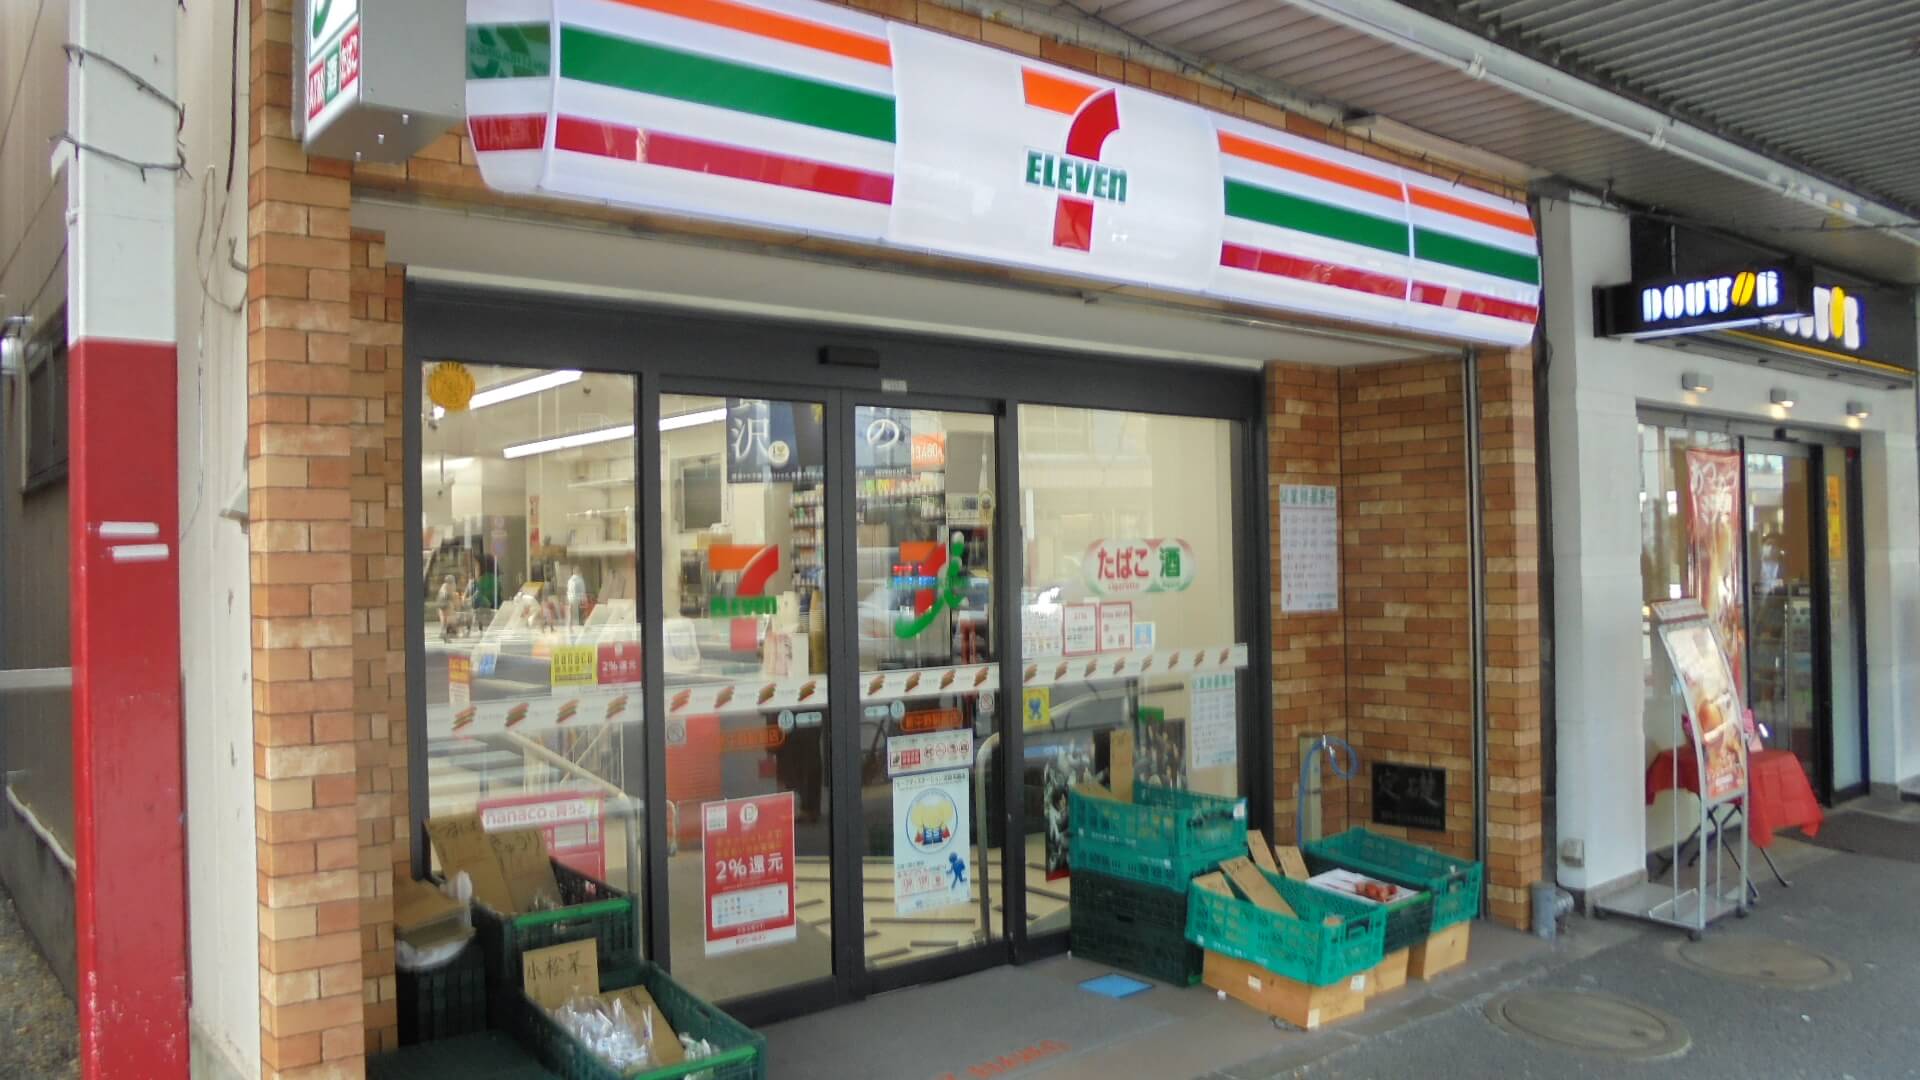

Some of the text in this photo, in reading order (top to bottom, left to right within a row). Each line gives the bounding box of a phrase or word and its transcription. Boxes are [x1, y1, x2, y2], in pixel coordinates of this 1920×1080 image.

[1643, 271, 1778, 322] DOUTOR
[1097, 546, 1180, 580] たばこ 酒
[714, 852, 784, 882] 2%還元
